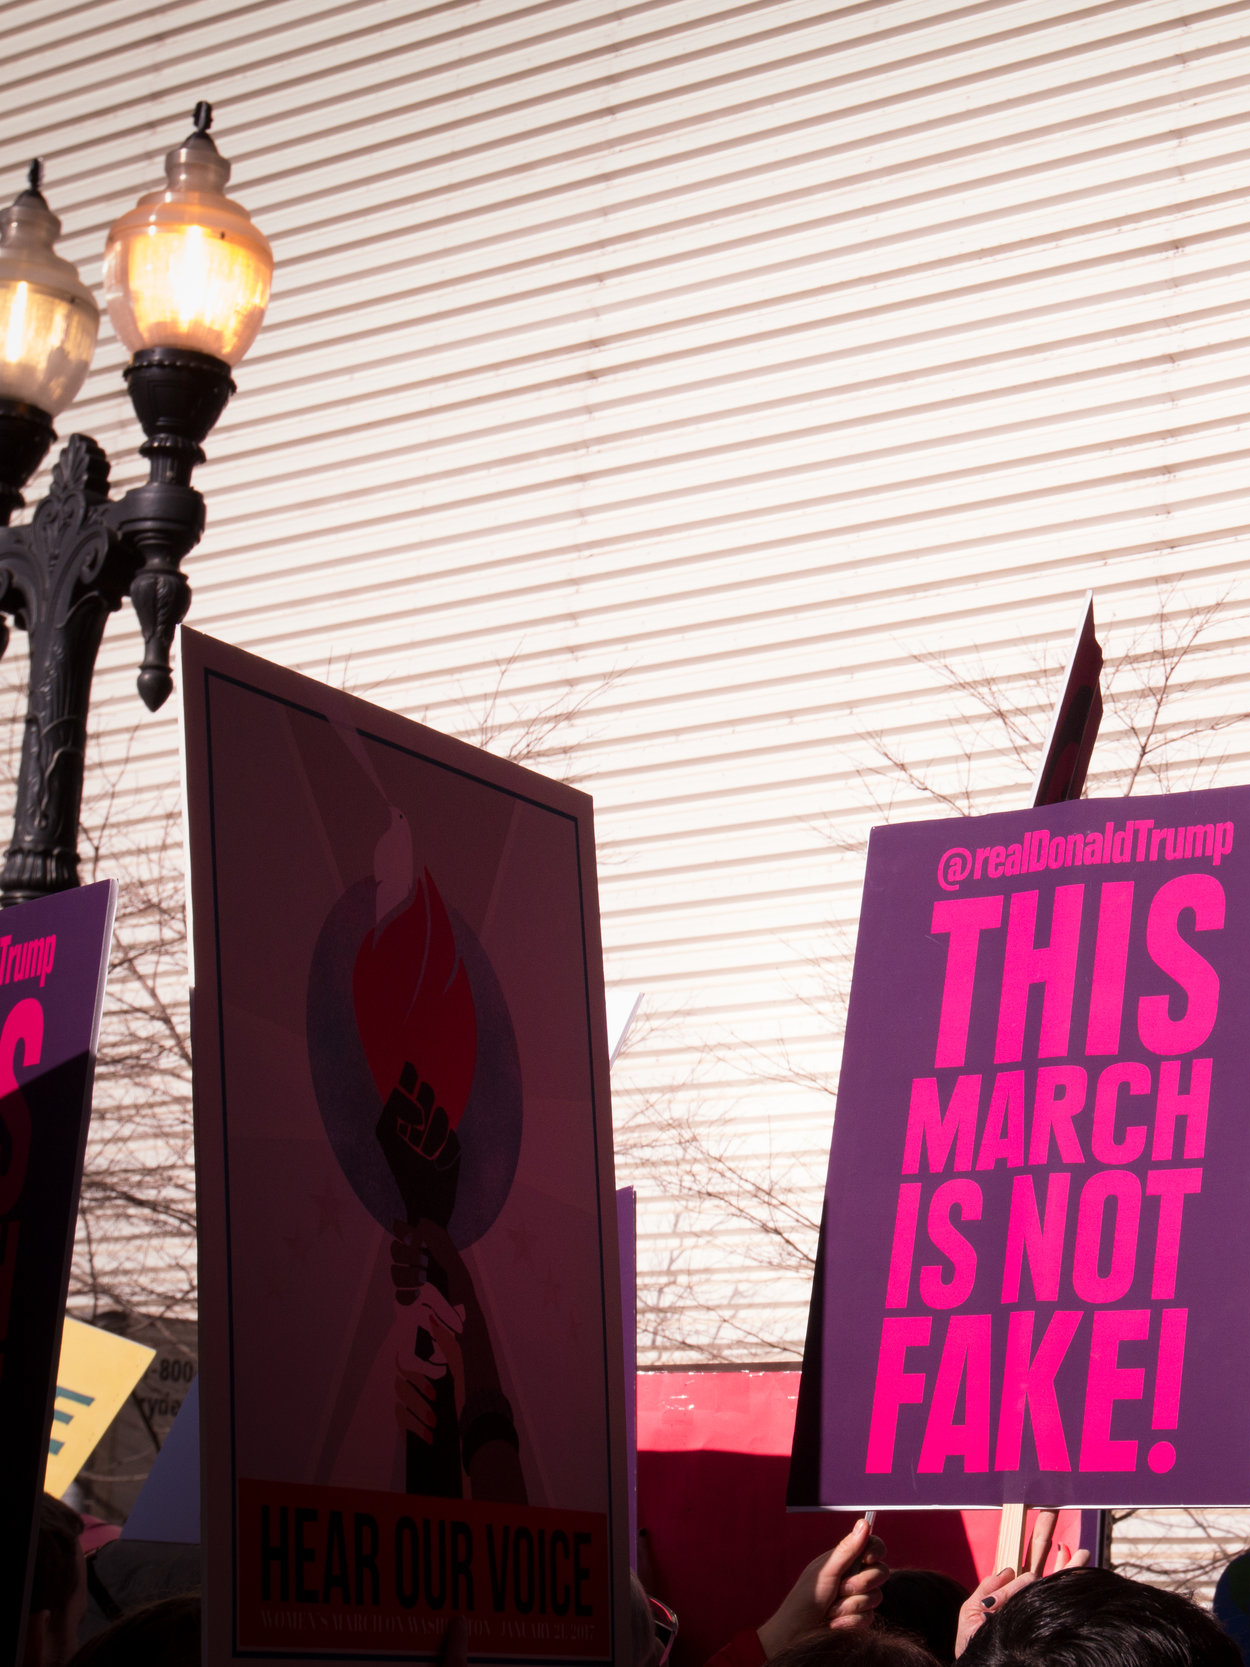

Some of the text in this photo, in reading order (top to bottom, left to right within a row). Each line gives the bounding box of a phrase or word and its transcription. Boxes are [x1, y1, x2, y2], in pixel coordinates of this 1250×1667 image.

[937, 819, 1235, 892] @realDonaldTrump
[930, 874, 1226, 1070] THIS
[901, 1058, 1213, 1175] MARCH
[885, 1168, 1203, 1310] IS NOT
[865, 1308, 1188, 1474] FAKE!
[261, 1505, 593, 1616] HEAR OUR VOICE
